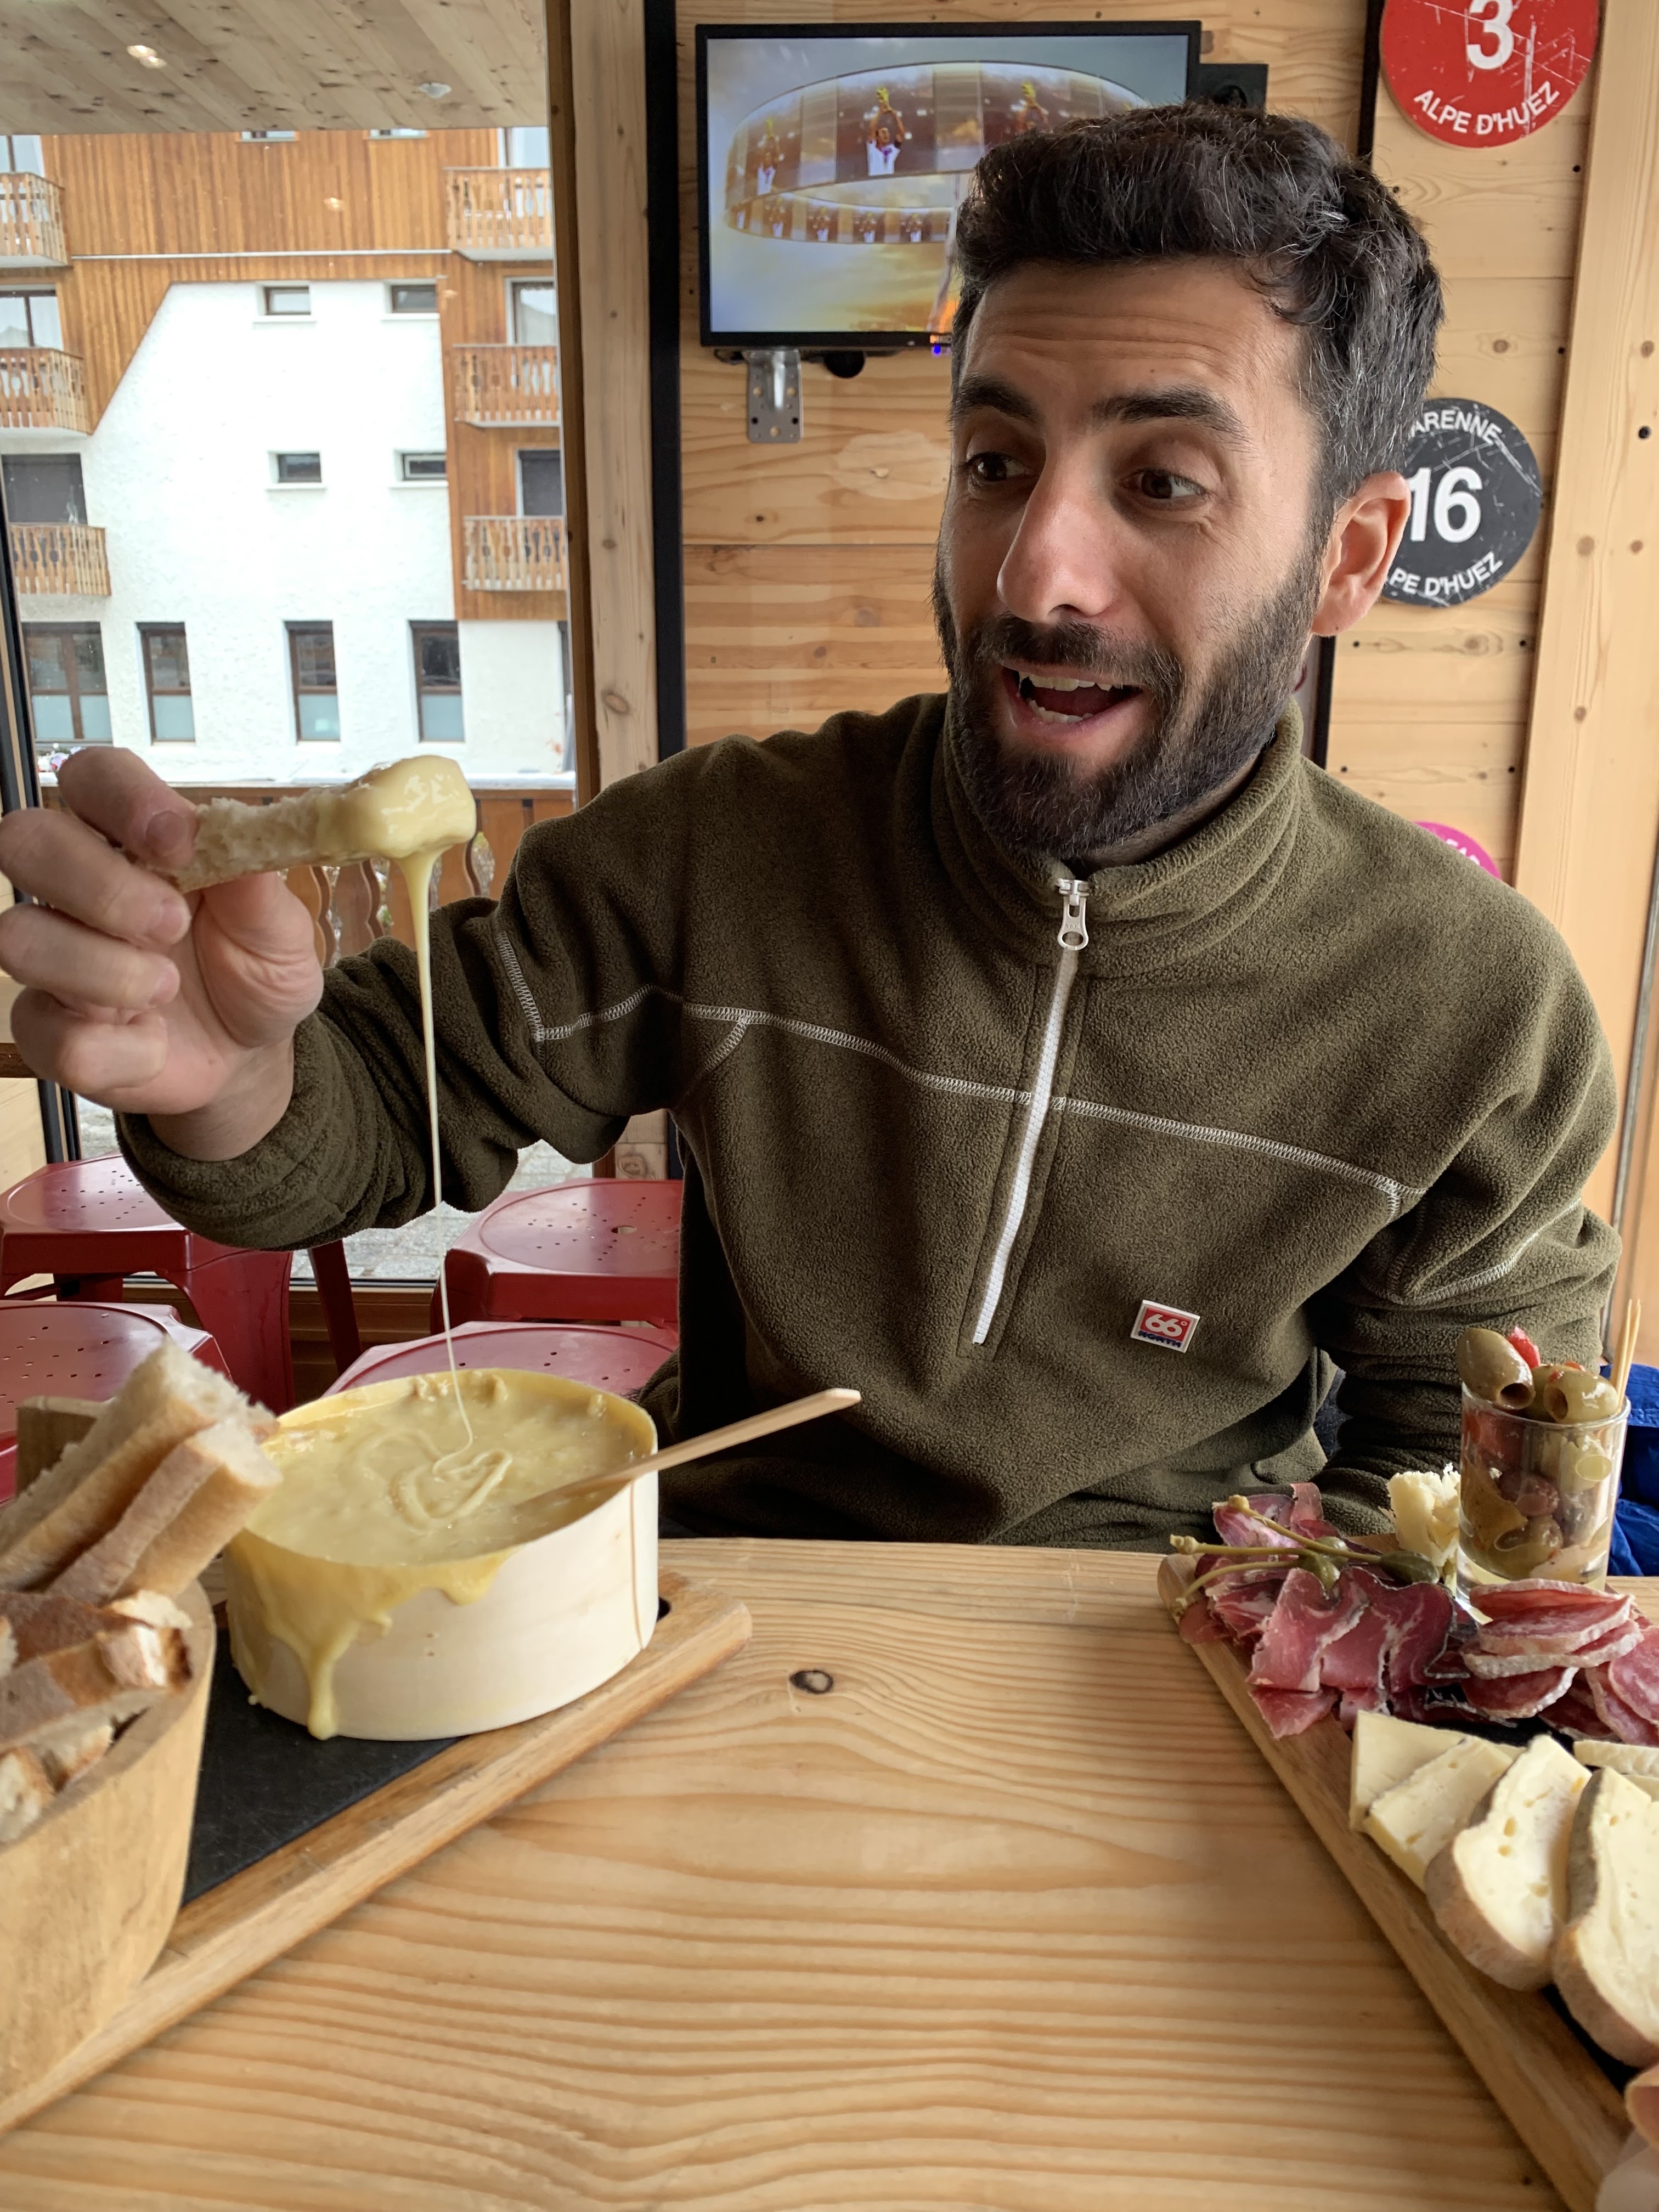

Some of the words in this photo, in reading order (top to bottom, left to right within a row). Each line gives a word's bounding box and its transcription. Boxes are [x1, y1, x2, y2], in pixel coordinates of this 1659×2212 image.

[1466, 0, 1514, 70] 3
[1413, 89, 1472, 134] ALPE
[1476, 80, 1560, 135] D'HUEZ
[1410, 409, 1503, 445] ARENNE
[1408, 466, 1483, 543] 16
[1387, 567, 1421, 594] PE
[1425, 551, 1504, 596] D'HUEZ
[1138, 1330, 1182, 1348] NORTH
